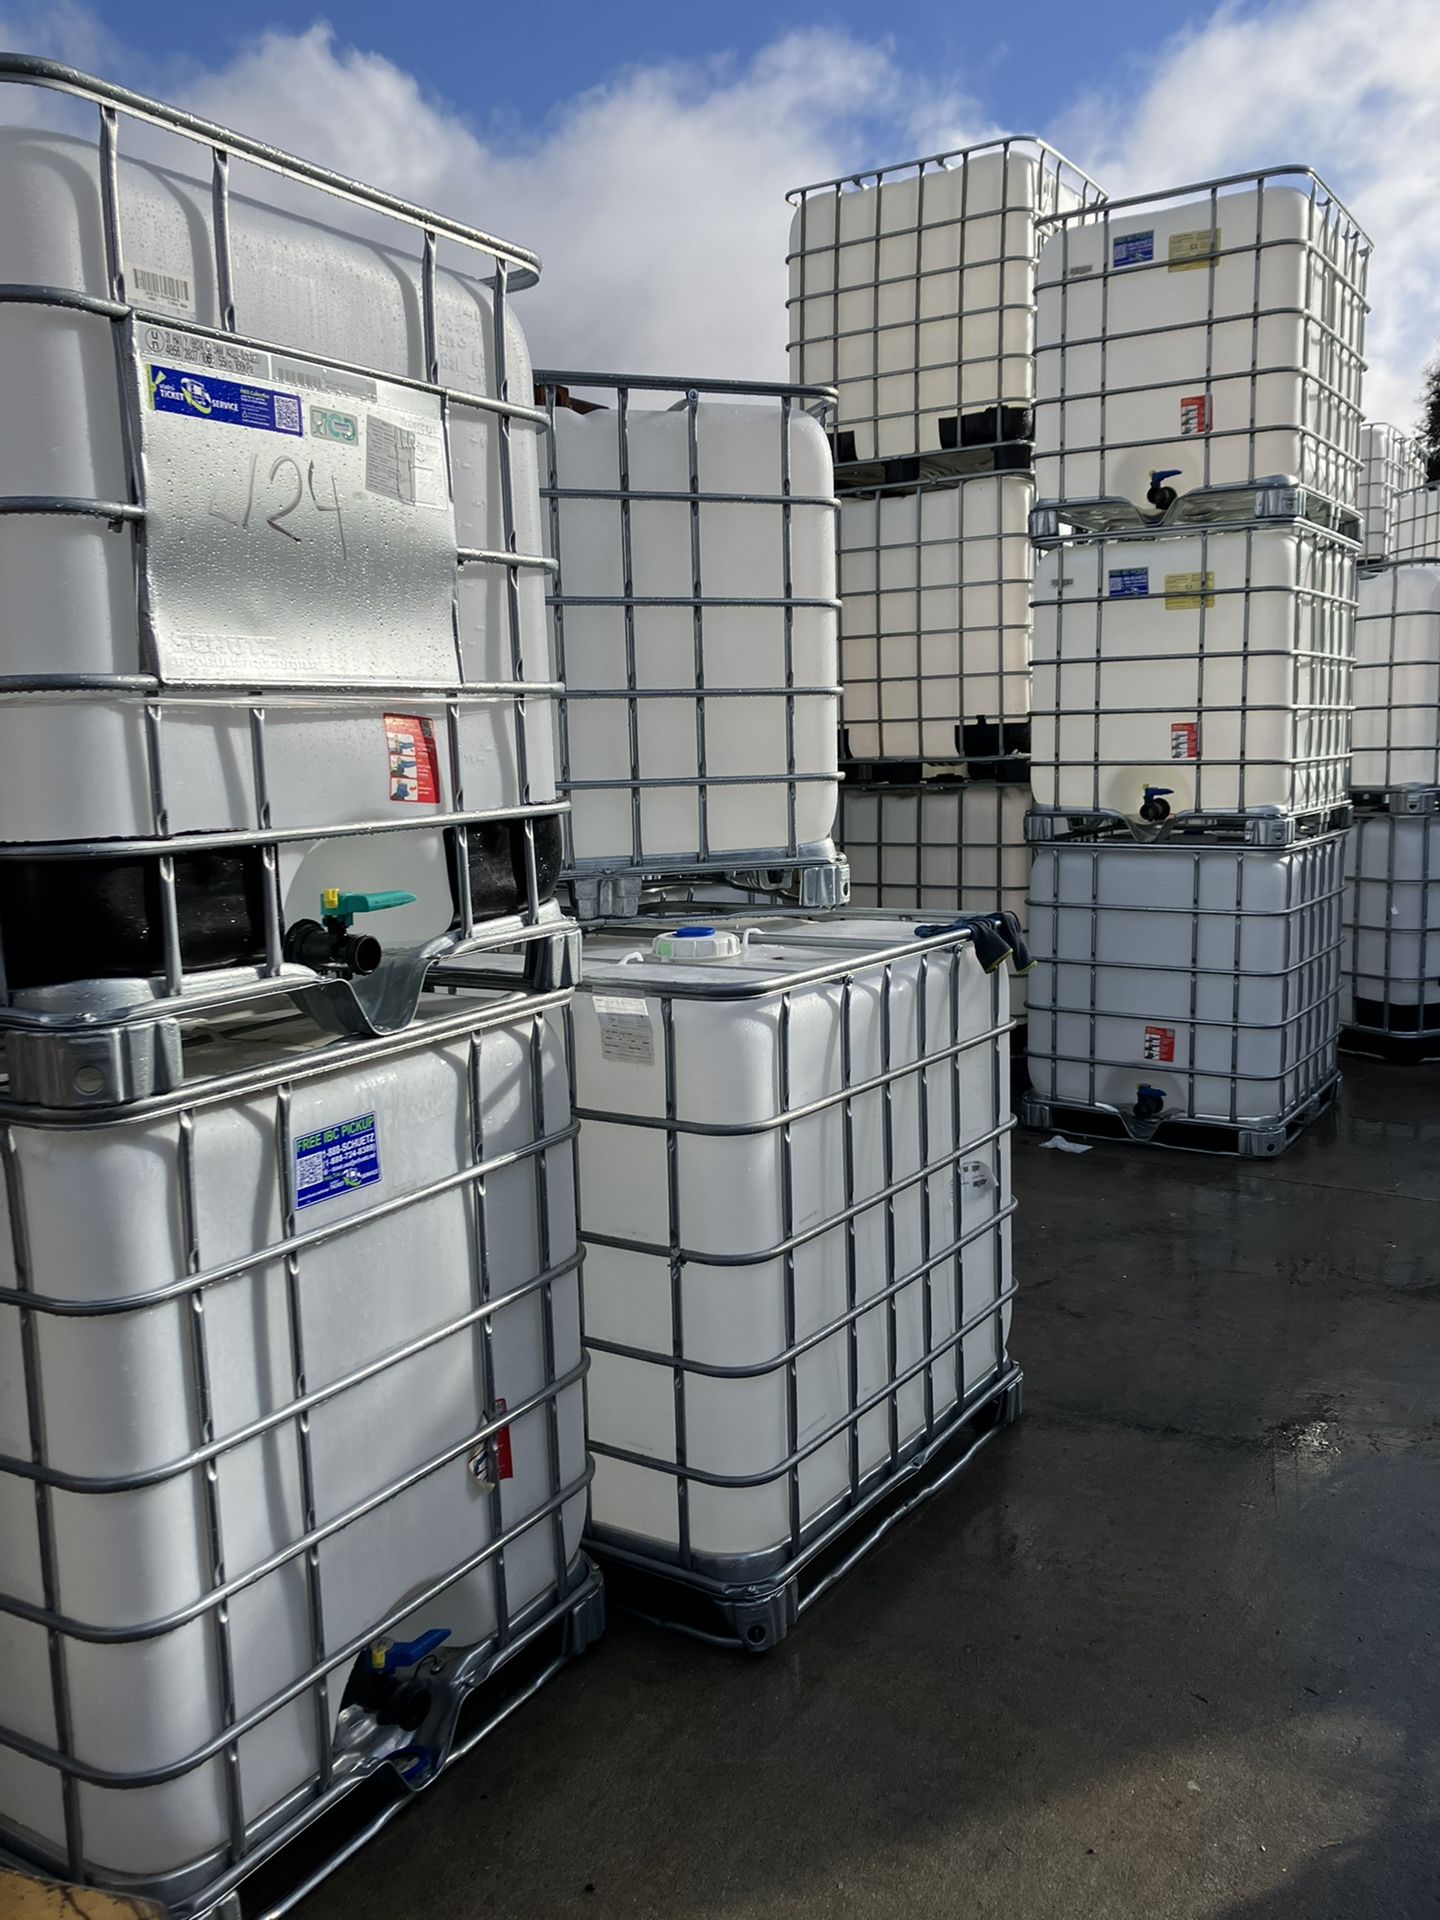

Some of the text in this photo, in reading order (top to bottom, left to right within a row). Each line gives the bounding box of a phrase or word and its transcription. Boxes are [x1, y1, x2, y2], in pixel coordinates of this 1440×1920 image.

[160, 390, 239, 412] TICKET SERVICE
[297, 1116, 373, 1152] FREE IBC PICKUP
